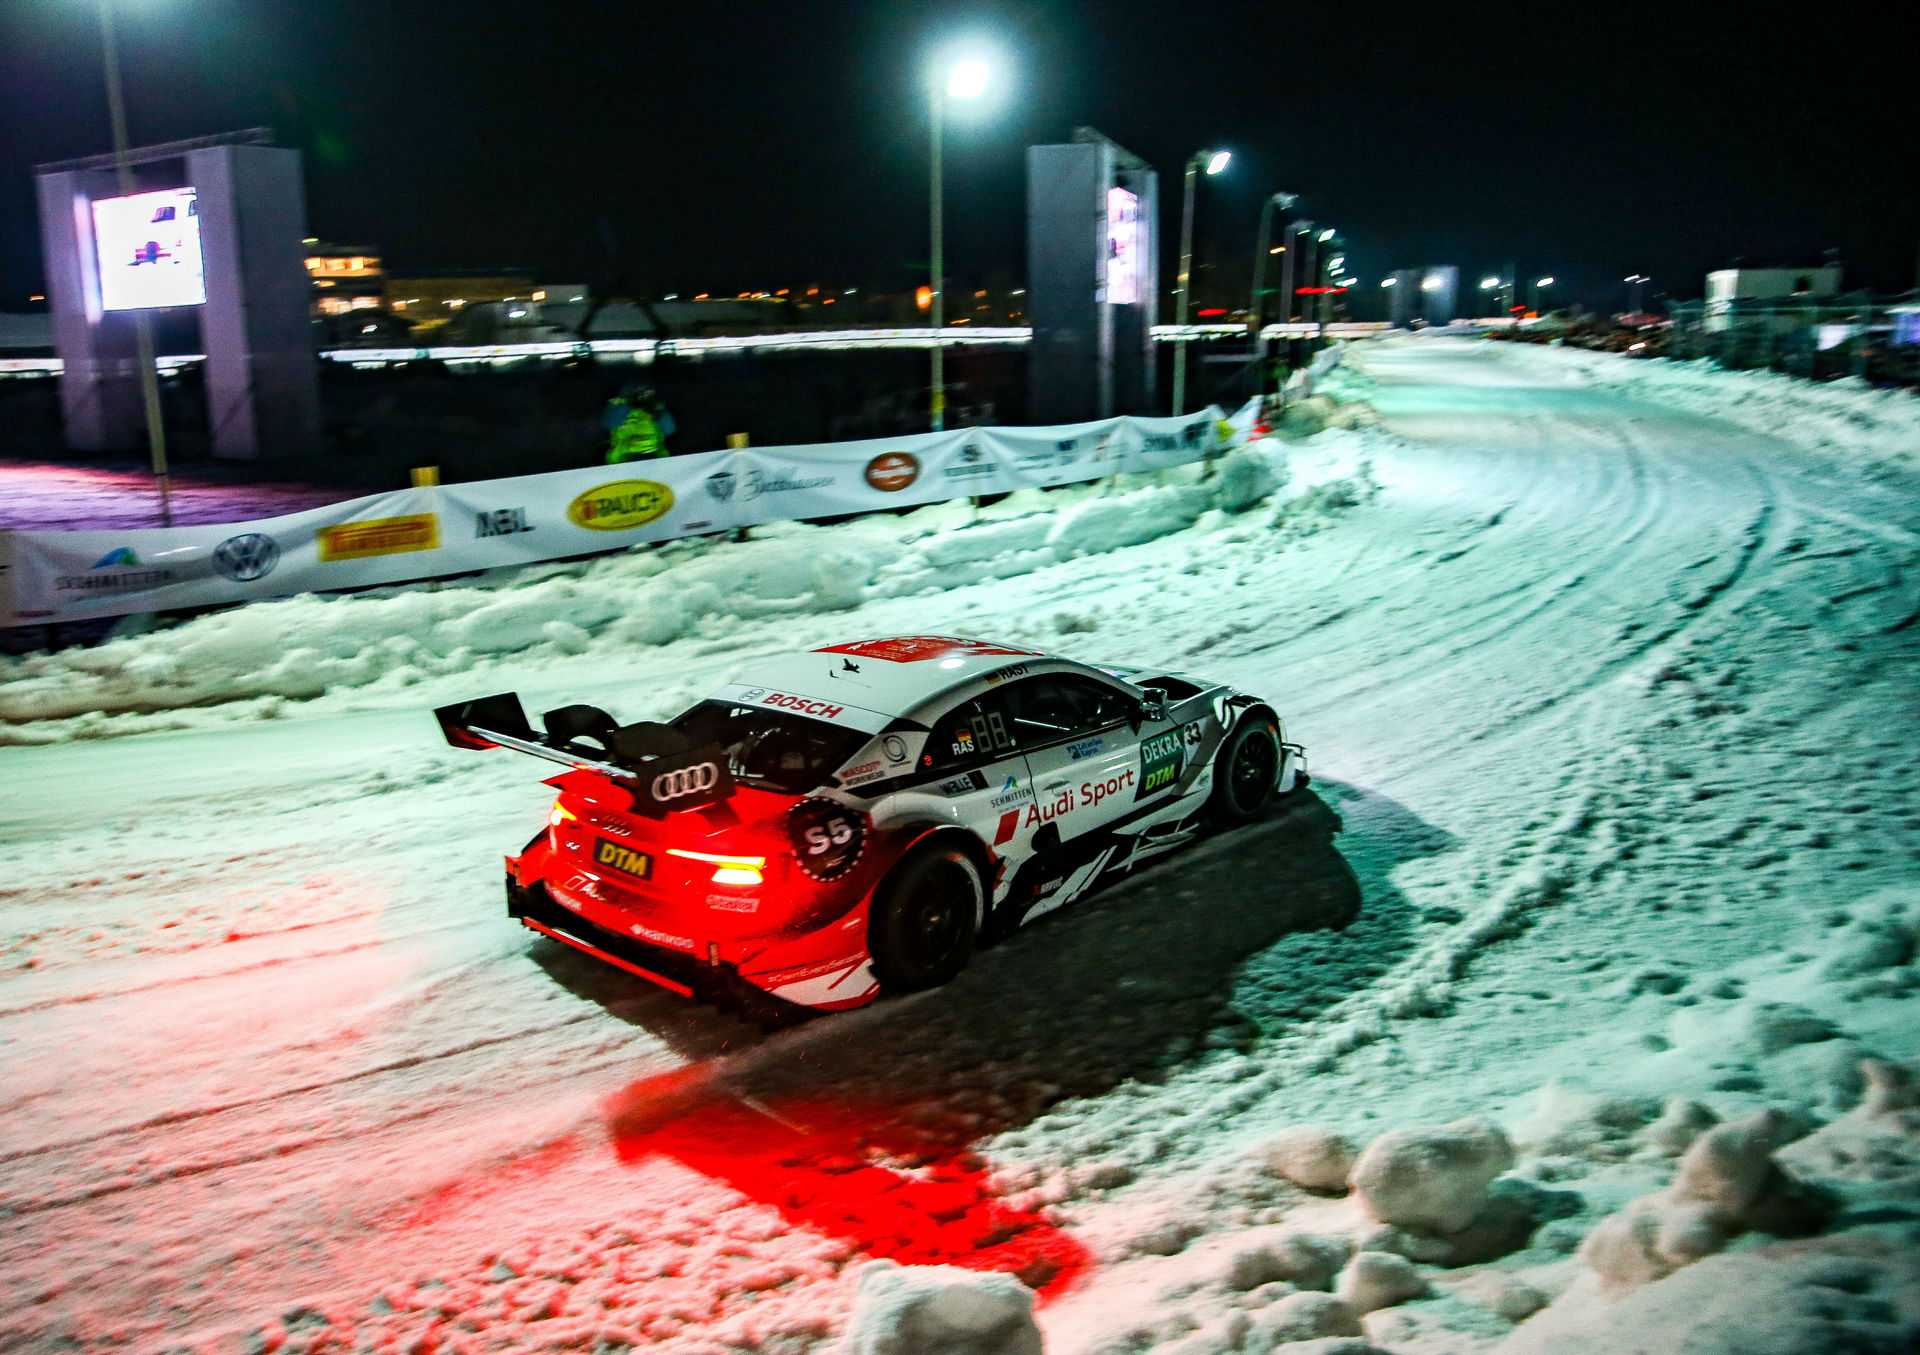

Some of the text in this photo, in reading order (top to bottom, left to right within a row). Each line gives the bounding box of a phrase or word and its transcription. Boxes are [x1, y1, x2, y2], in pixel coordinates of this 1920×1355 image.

[999, 663, 1030, 680] RAST
[762, 693, 845, 718] BOSCH
[1185, 722, 1202, 746] 33
[952, 740, 975, 755] RAS
[1142, 733, 1182, 764] DEKRA
[1145, 764, 1175, 791] DTM
[991, 788, 1032, 808] SCHMITTEN
[1025, 769, 1135, 828] Audi Sport
[805, 817, 853, 855] S5
[600, 842, 649, 877] DTM
